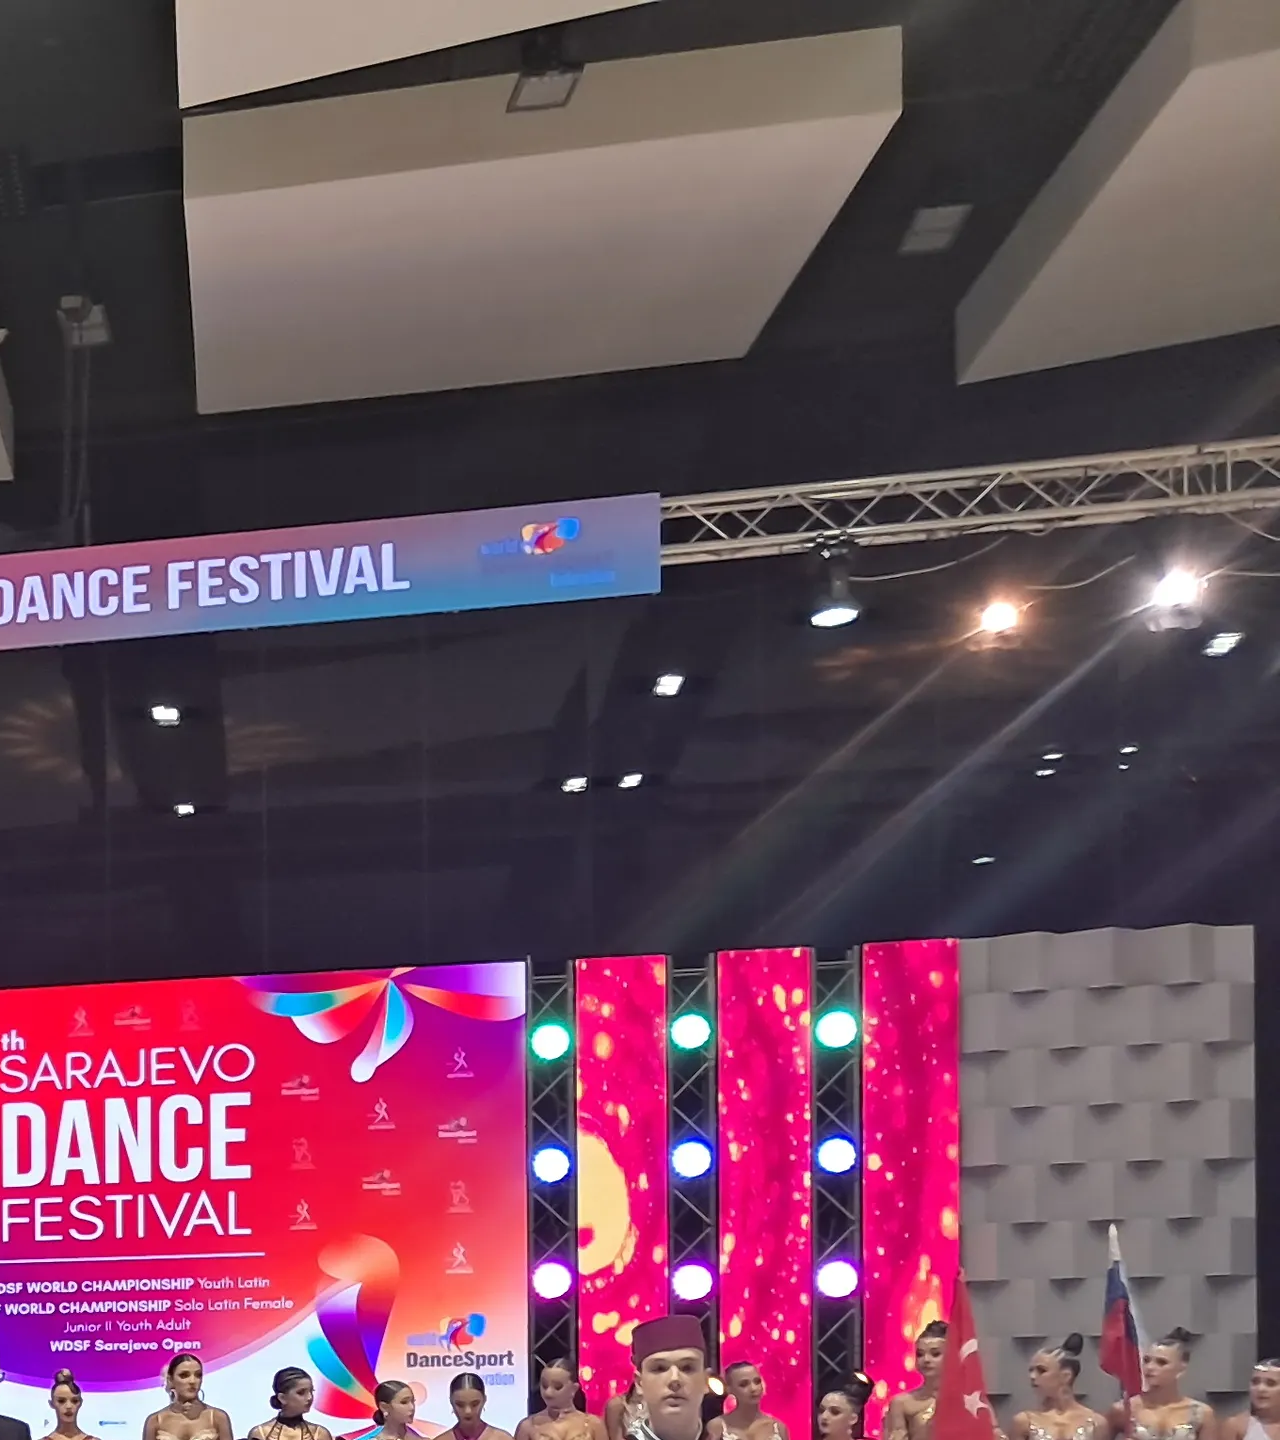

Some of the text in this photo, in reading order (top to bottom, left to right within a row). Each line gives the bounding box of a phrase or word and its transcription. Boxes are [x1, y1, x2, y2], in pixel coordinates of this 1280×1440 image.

[167, 542, 410, 610] FESTIVAL
[0, 1043, 256, 1093] SARAJEVO
[1, 1092, 252, 1188] DANCE
[2, 1190, 252, 1243] FESTIVAL
[26, 1281, 78, 1294] WORLD
[81, 1278, 195, 1293] CHAMPIONSHIP
[197, 1277, 234, 1290] Youth
[238, 1276, 270, 1289] Latin
[5, 1302, 56, 1315] WORLD
[59, 1300, 172, 1314] CHAMPIONSHIP
[174, 1299, 204, 1311] Solo
[208, 1298, 240, 1311] Latin
[243, 1296, 294, 1310] Female
[64, 1322, 101, 1333] Junior
[116, 1318, 153, 1332] Youth
[156, 1318, 192, 1331] Adult
[50, 1338, 202, 1354] WDSF Sarajevo Open
[406, 1350, 515, 1370] DanceSport
